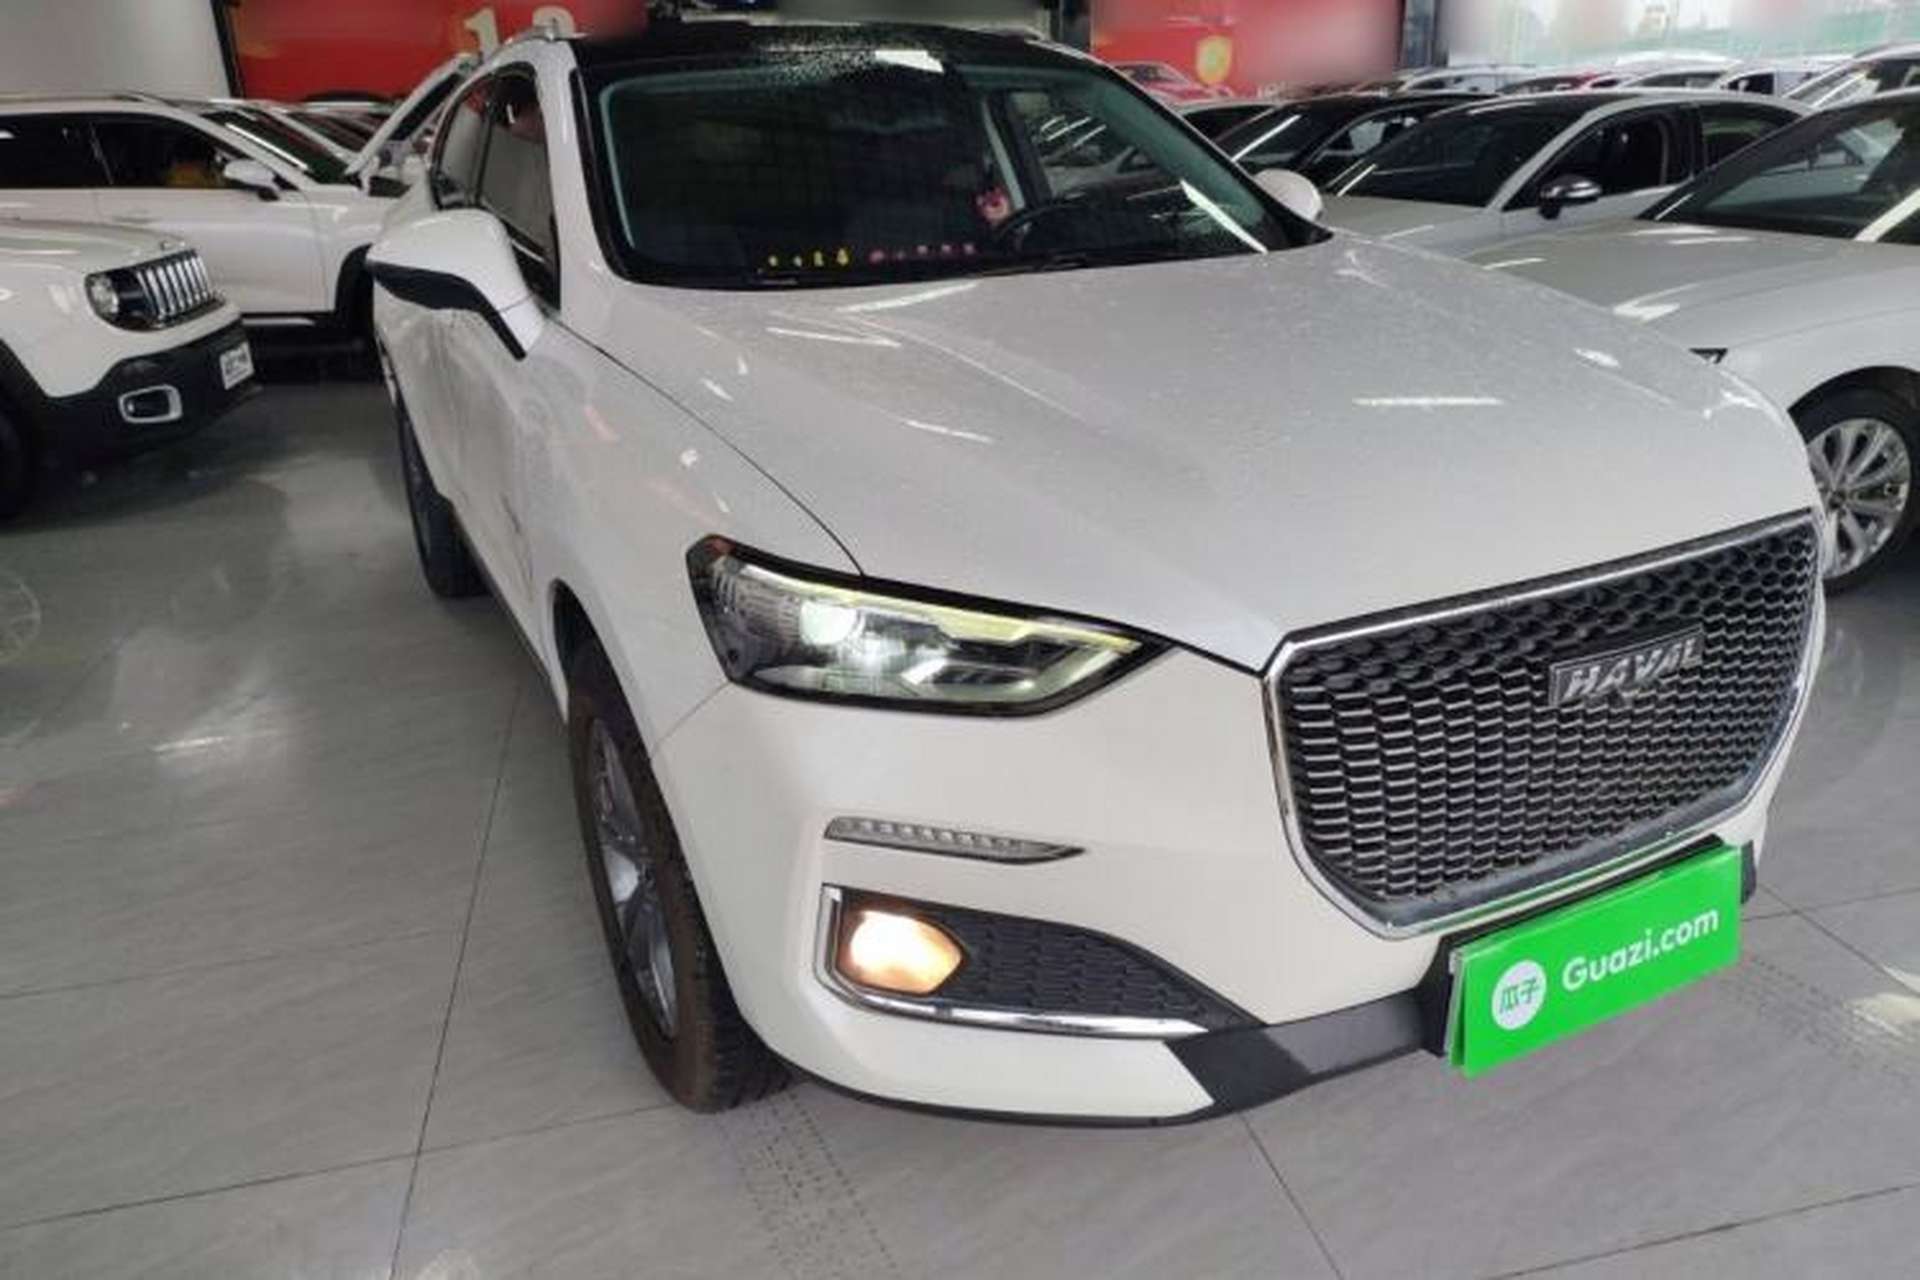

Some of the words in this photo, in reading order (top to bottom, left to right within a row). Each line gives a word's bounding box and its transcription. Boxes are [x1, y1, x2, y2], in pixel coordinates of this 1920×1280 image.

[1563, 638, 1702, 701] HAVAL
[1562, 908, 1719, 991] Guazi.com
[1499, 976, 1541, 1014] 瓜子
